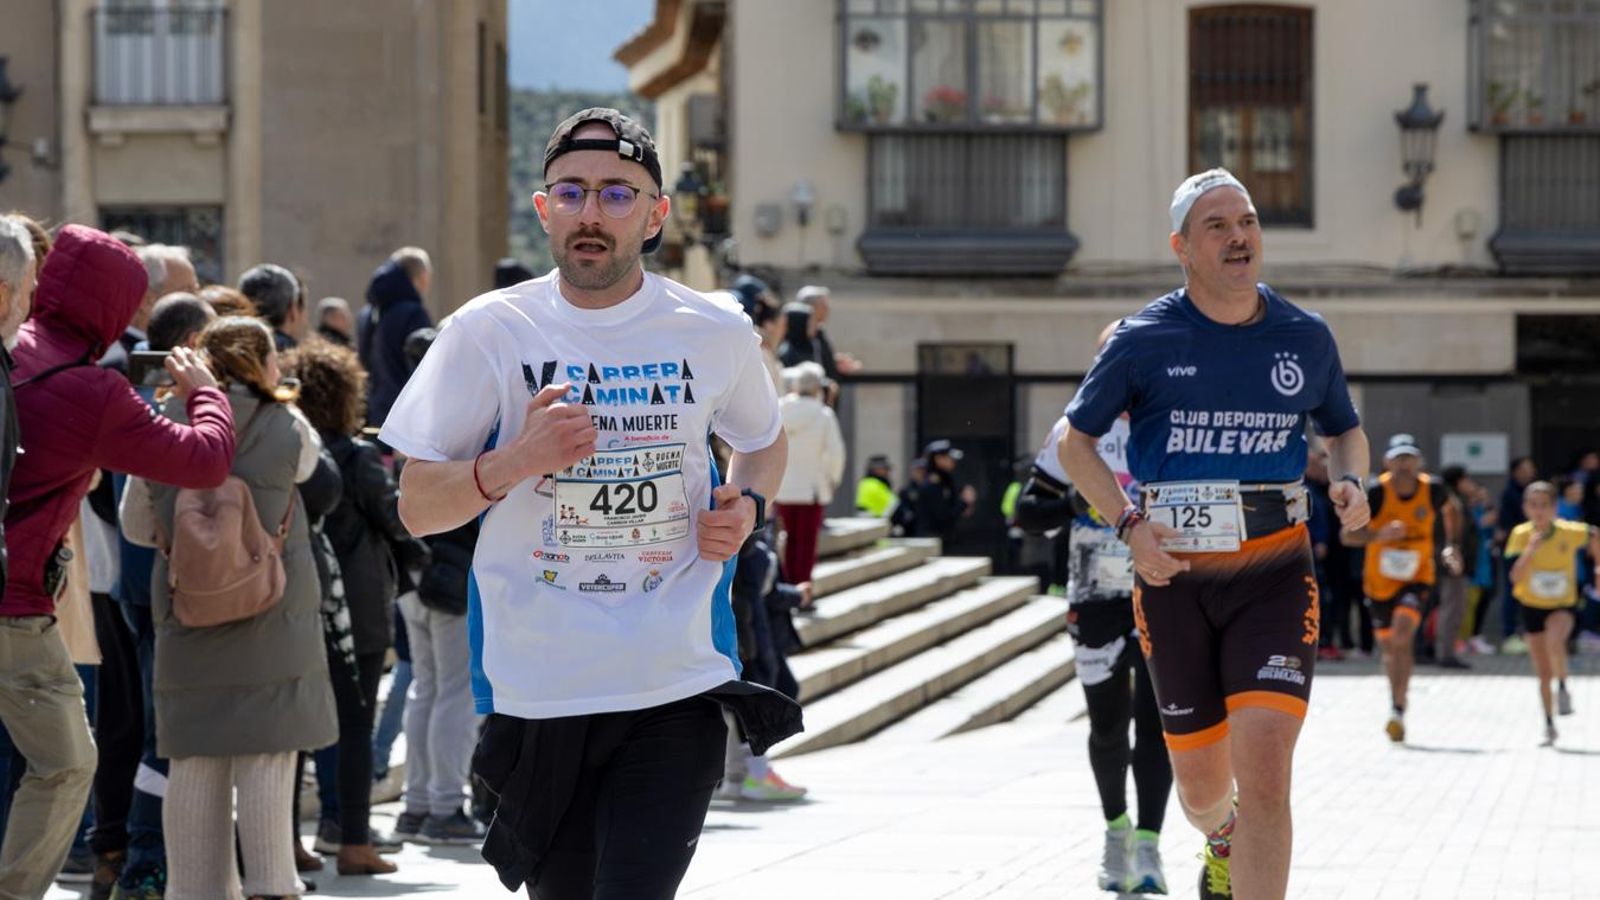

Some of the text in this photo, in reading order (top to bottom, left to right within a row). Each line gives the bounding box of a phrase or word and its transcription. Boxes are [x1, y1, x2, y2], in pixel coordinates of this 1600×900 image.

[566, 358, 694, 384] CARRERA
[1166, 365, 1198, 377] vive
[561, 382, 696, 407] CAMINATA
[590, 413, 678, 432] ENA MUERTE
[1169, 409, 1298, 429] CLUB DEPORTIVO
[656, 451, 680, 461] BUENA
[656, 460, 679, 471] MUERTE
[576, 466, 640, 478] CAMINATA
[590, 480, 658, 515] 420
[1170, 505, 1212, 529] 125
